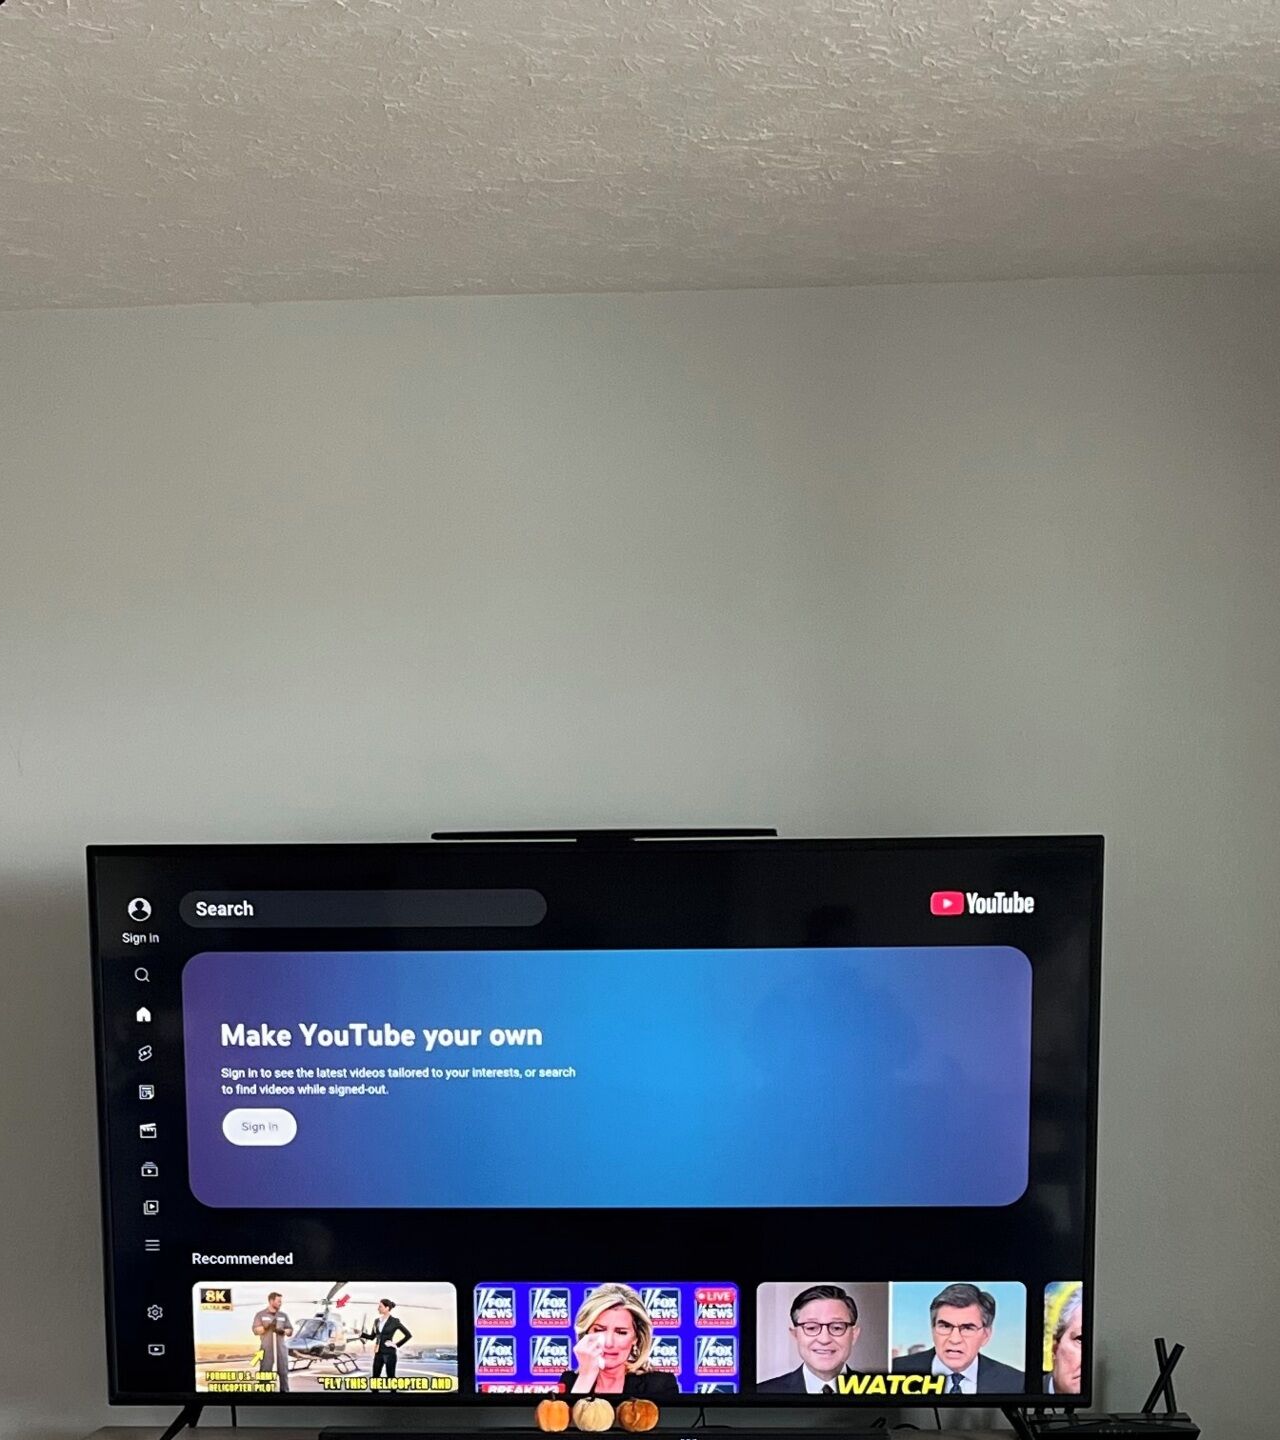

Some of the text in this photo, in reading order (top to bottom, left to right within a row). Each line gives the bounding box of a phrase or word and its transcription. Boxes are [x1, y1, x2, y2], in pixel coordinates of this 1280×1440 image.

[966, 891, 1035, 914] YouTube
[195, 900, 254, 917] Search
[122, 932, 147, 946] Sign
[221, 1023, 543, 1052] Make YouTube your own
[221, 1067, 245, 1081] Sign
[260, 1068, 271, 1079] to
[274, 1069, 294, 1078] see
[296, 1067, 314, 1078] the
[316, 1067, 348, 1078] latest
[350, 1067, 386, 1078] videos
[388, 1067, 429, 1078] tailored
[431, 1068, 443, 1078] to
[445, 1069, 469, 1080] your
[472, 1067, 523, 1079] interests,
[524, 1068, 537, 1078] or
[538, 1067, 576, 1078] search
[221, 1083, 389, 1097] to find videos while signed-out.
[241, 1121, 266, 1134] Sign
[192, 1252, 294, 1265] Recommended
[205, 1290, 226, 1302] 8K
[706, 1291, 731, 1301] LIVE
[488, 1298, 512, 1308] FOX
[543, 1298, 567, 1308] FOX
[653, 1298, 677, 1308] FOX
[481, 1308, 513, 1318] NEWS
[536, 1308, 568, 1318] NEWS
[702, 1308, 733, 1318] NEWS
[489, 1346, 513, 1356] FOX
[544, 1346, 568, 1356] FOX
[653, 1346, 677, 1356] FOX
[709, 1346, 733, 1356] FOX
[482, 1356, 514, 1366] NEWS
[537, 1356, 569, 1366] NEWS
[702, 1356, 734, 1366] NEWS
[206, 1371, 236, 1380] FORMER
[208, 1383, 275, 1392] HELICOPTER PILOT
[345, 1378, 367, 1389] THIS
[370, 1378, 428, 1389] HELICOPTER
[431, 1378, 452, 1389] AND
[838, 1375, 945, 1394] WATCH
